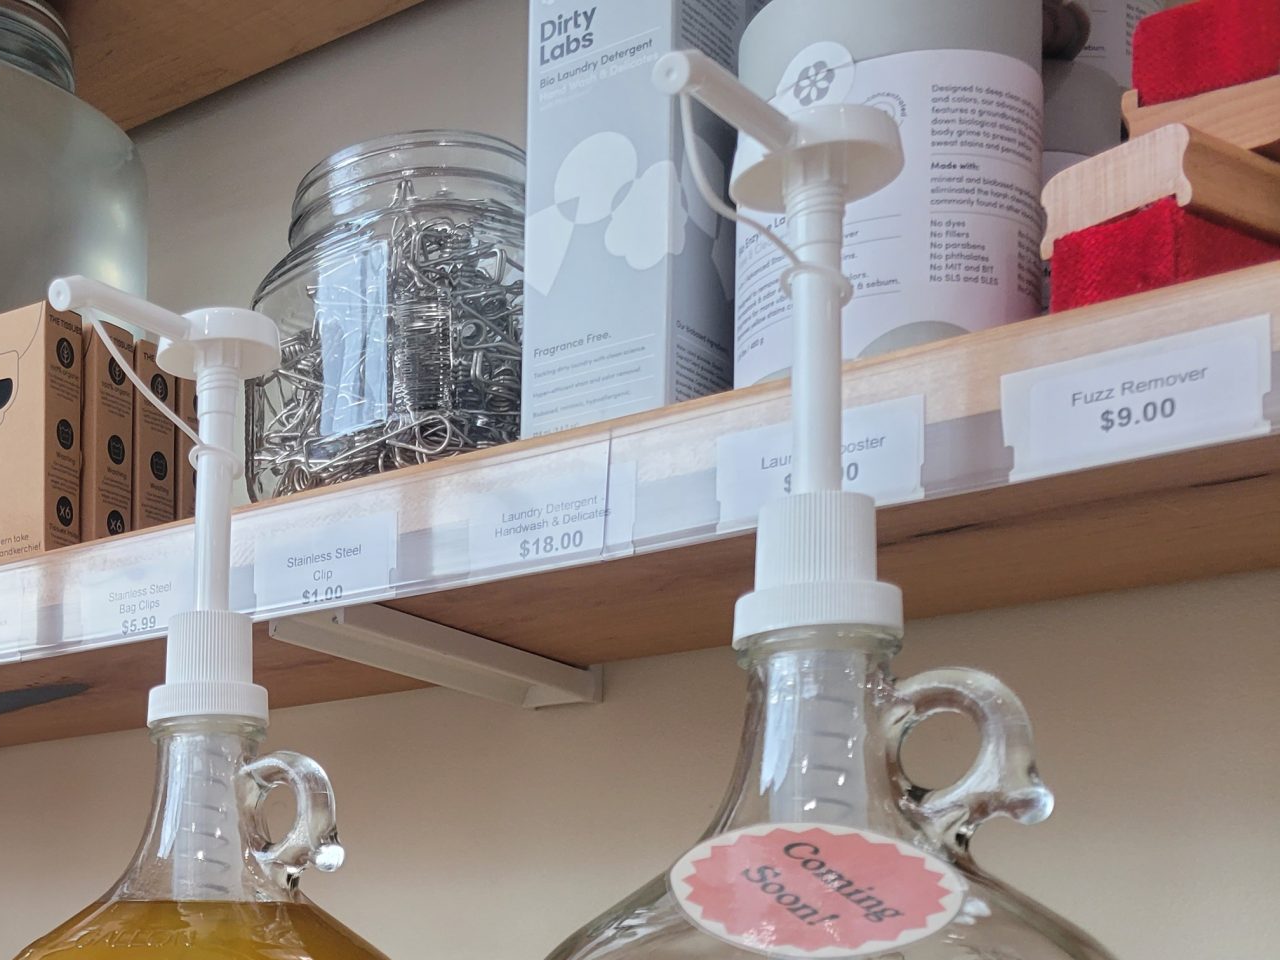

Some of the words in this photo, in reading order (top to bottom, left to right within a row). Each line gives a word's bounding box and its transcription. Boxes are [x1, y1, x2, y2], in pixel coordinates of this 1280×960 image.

[540, 7, 597, 43] Dirty
[540, 32, 594, 66] Labs
[540, 77, 554, 89] Bio
[557, 60, 598, 82] Laundry
[600, 38, 653, 65] Detergent
[931, 84, 973, 93] Designed
[931, 106, 968, 114] features
[931, 117, 956, 125] down
[931, 128, 954, 137] body
[956, 129, 981, 138] grime
[930, 162, 957, 170] Made
[965, 176, 981, 184] and
[930, 187, 975, 195] eliminated
[977, 188, 989, 196] the
[930, 198, 974, 207] commonly
[945, 219, 966, 229] dyes
[945, 230, 969, 239] fillers
[945, 242, 986, 252] parabens
[945, 252, 989, 262] phthalates
[930, 263, 942, 271] No
[945, 263, 961, 271] MIT
[964, 264, 980, 272] and
[866, 278, 900, 289] sebum.
[945, 274, 961, 282] SLS
[963, 275, 979, 283] and
[533, 338, 584, 359] Fragrance
[586, 330, 611, 344] Free.
[144, 352, 155, 362] THE
[1072, 386, 1115, 407] Fuzz
[1121, 366, 1208, 397] Remover
[1100, 397, 1176, 432] $9.00
[840, 436, 886, 455] ooster
[502, 506, 542, 523] Laundry
[546, 495, 598, 514] Detergent
[495, 518, 549, 538] Handwash
[552, 517, 560, 527] &
[563, 508, 611, 525] Delicates
[14, 533, 29, 542] take
[520, 530, 584, 559] $18.00
[286, 552, 335, 570] Stainless
[336, 544, 362, 561] Steel
[313, 566, 333, 582] Clip
[108, 584, 148, 602] Stainless
[149, 581, 171, 595] Steel
[302, 585, 343, 605] $1.00
[119, 602, 136, 615] Bag
[139, 599, 160, 612] Clips
[121, 615, 156, 636] $5.99
[783, 841, 904, 924] Coming
[741, 864, 840, 927] Soon!
